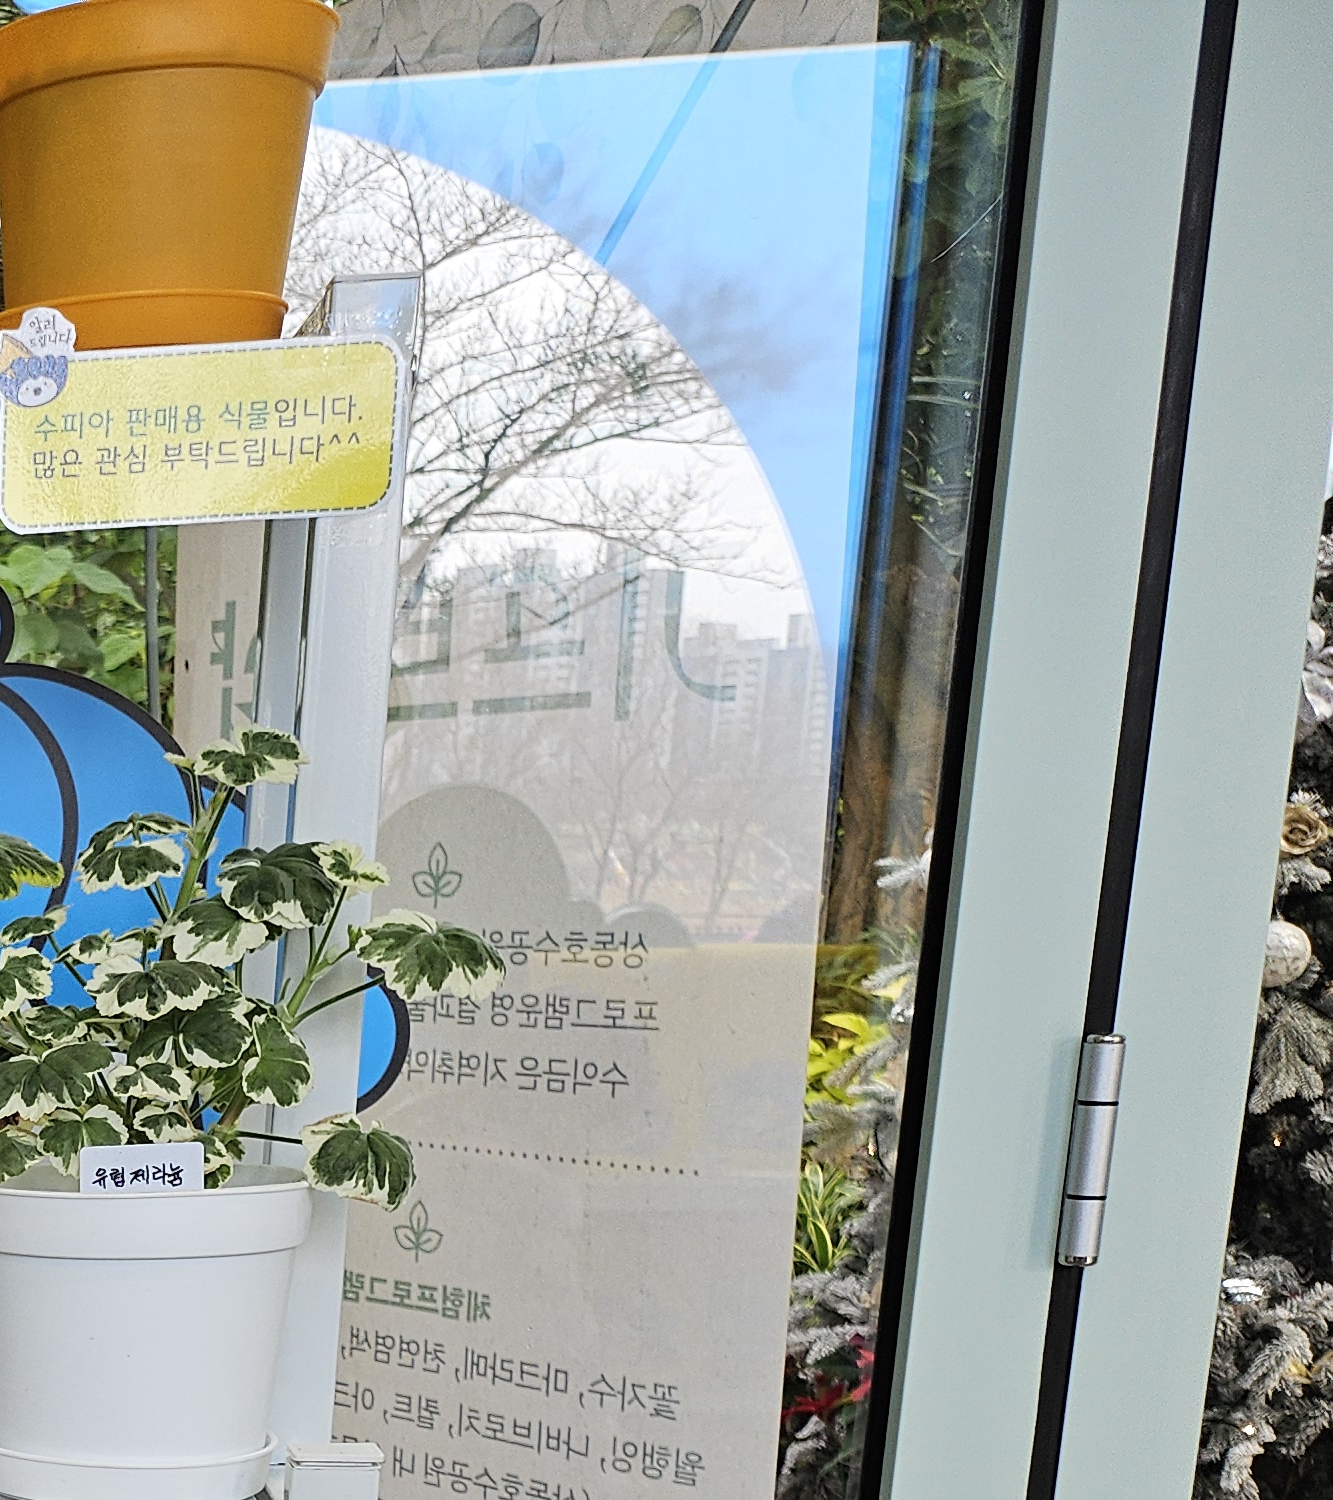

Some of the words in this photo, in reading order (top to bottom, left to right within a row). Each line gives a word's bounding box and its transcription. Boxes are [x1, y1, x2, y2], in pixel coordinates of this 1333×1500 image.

[34, 408, 113, 444] 수피아
[125, 404, 207, 438] 판매용
[218, 394, 364, 432] 식물입니다.
[33, 448, 84, 481] 많은
[94, 443, 150, 477] 관심
[160, 432, 362, 472] 부탁드립니다^^
